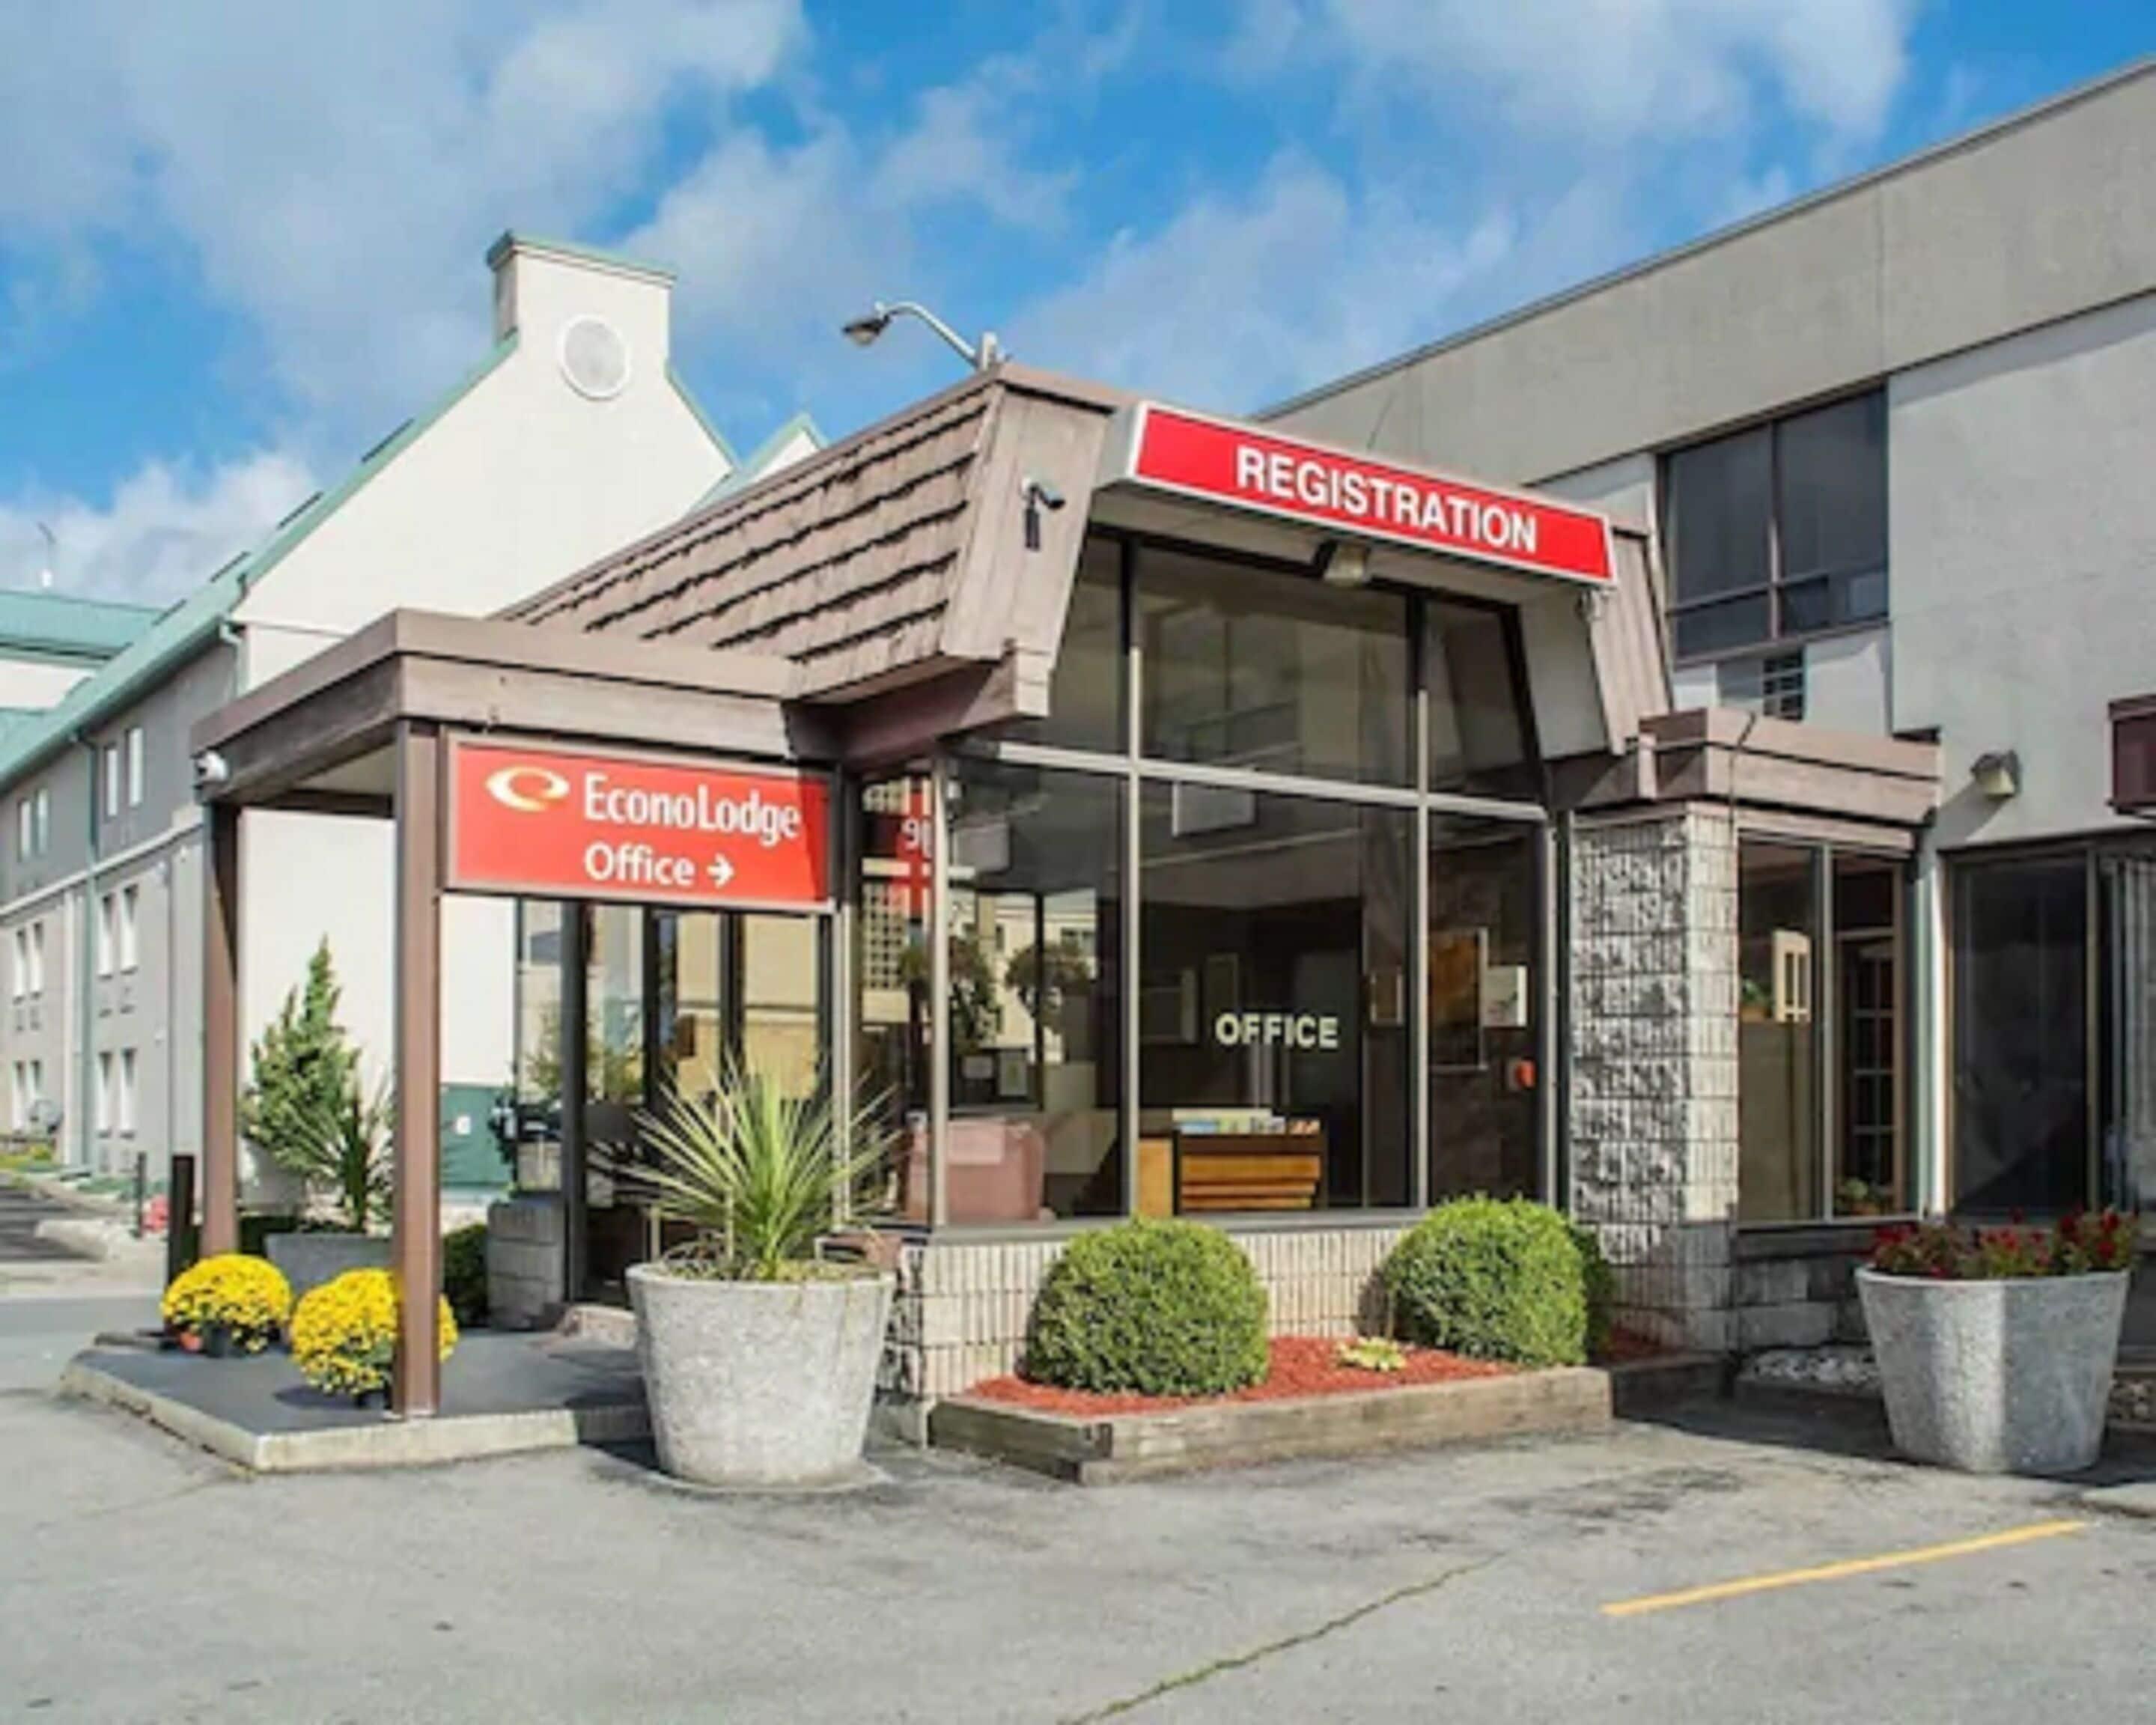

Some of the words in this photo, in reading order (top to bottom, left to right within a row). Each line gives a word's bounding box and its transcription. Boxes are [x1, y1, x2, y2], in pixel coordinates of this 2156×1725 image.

[1236, 445, 1537, 553] REGISTRATION
[583, 770, 800, 848] EconoLodge
[583, 842, 695, 886] Office
[1215, 1012, 1339, 1048] OFFICE
